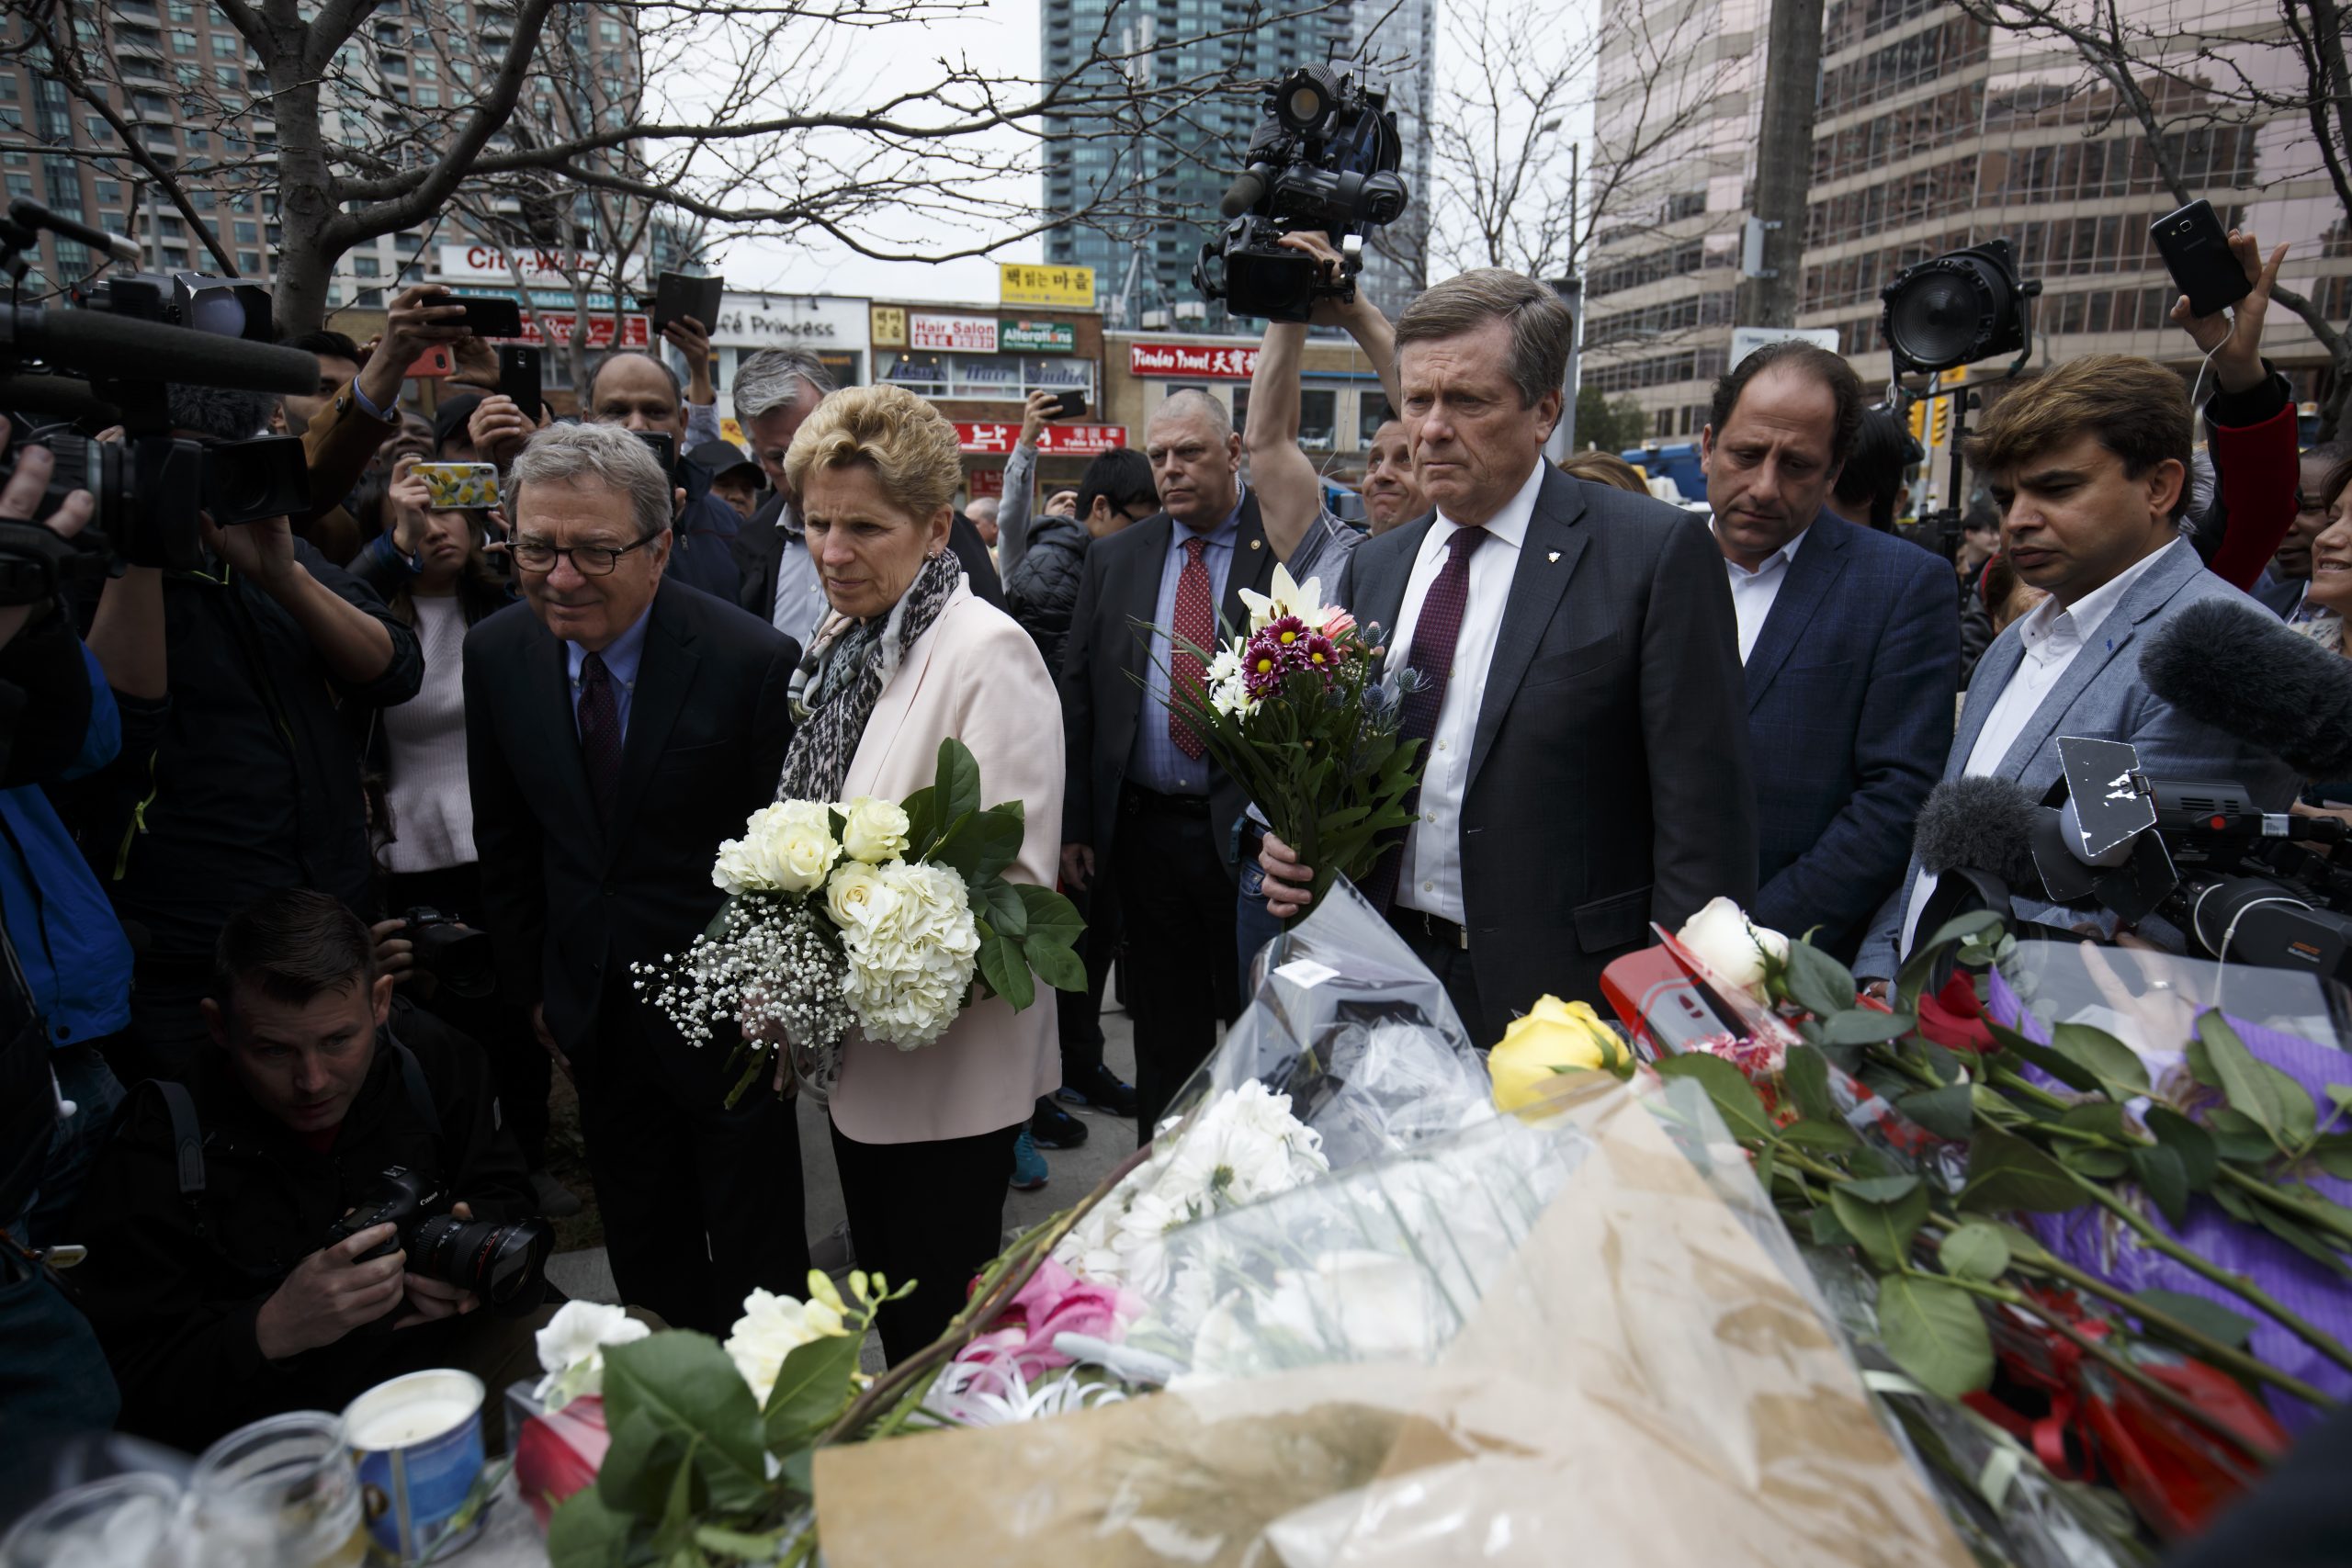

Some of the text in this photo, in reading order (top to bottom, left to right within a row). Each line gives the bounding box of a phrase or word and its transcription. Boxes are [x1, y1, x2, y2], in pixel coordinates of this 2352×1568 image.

[716, 310, 835, 336] fé Princess
[916, 321, 994, 334] Hair Salon
[1003, 328, 1073, 344] Alterations
[966, 363, 1009, 381] Hair
[1025, 365, 1086, 386] Studio
[420, 1191, 438, 1206] Canon
